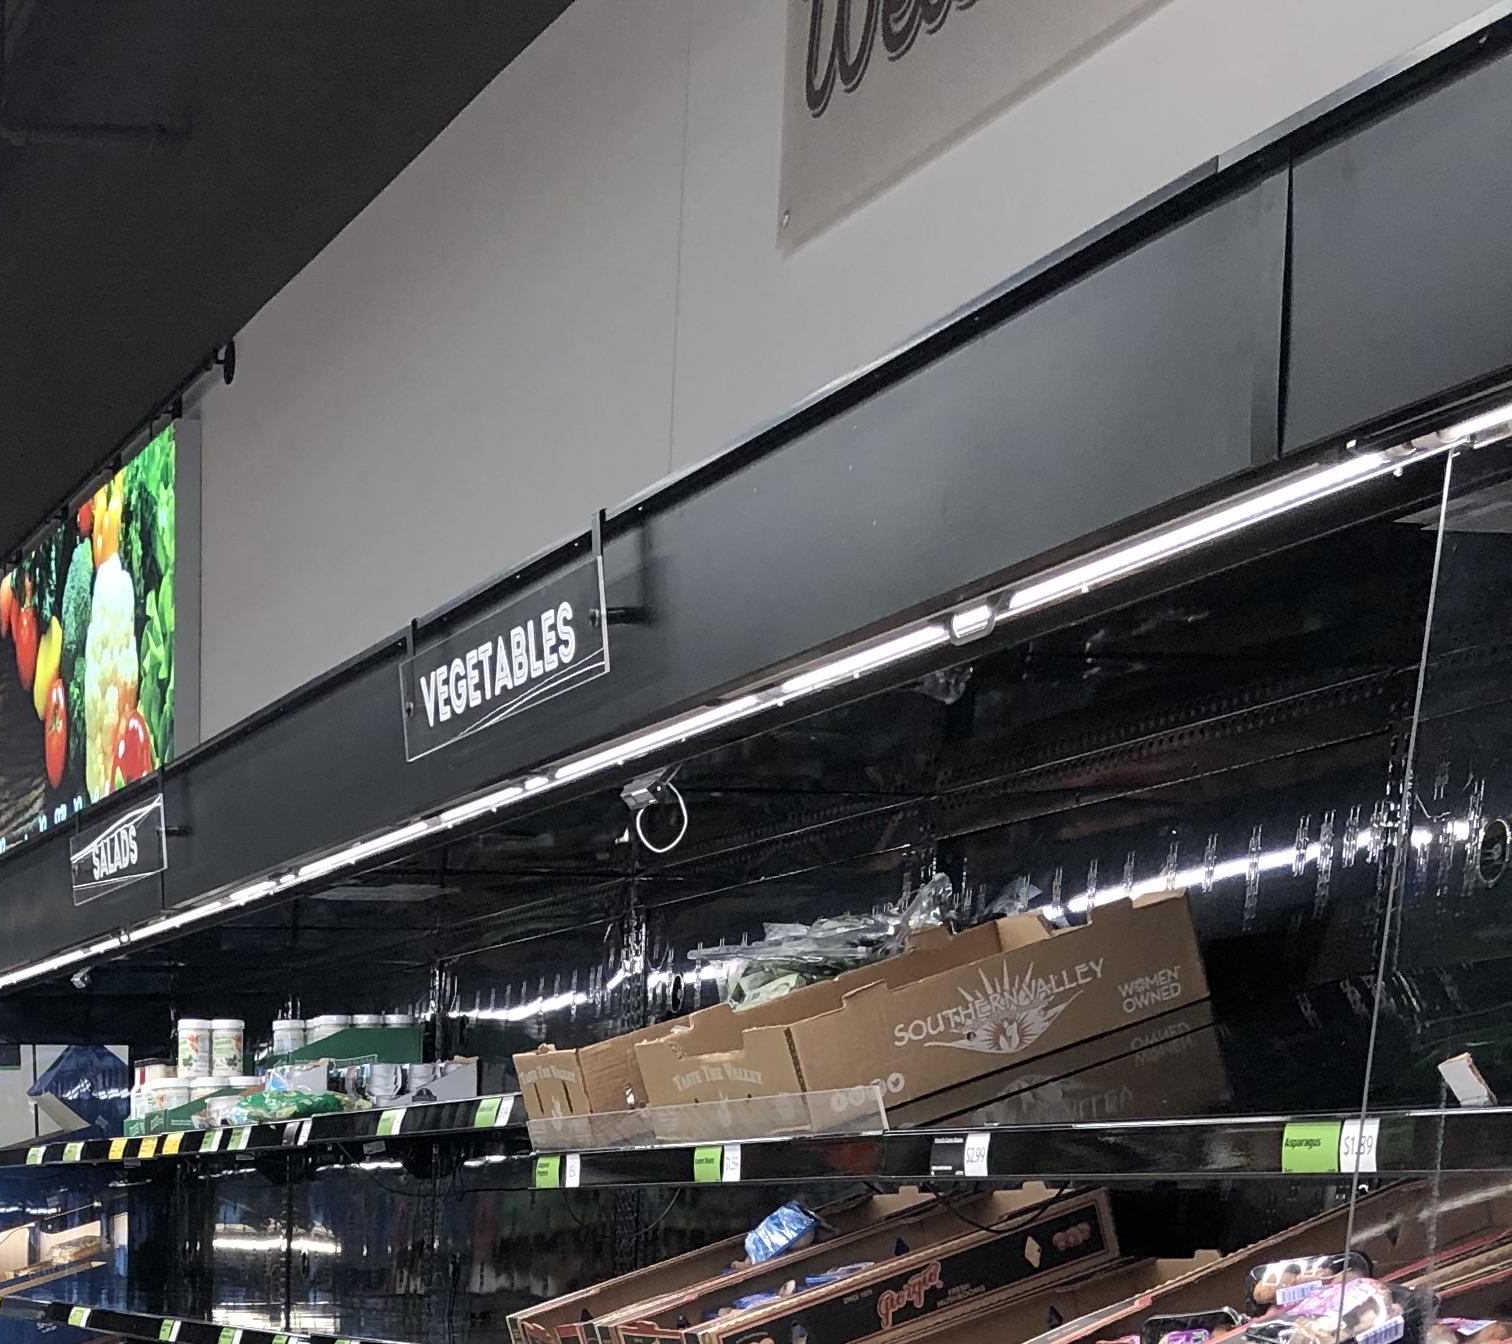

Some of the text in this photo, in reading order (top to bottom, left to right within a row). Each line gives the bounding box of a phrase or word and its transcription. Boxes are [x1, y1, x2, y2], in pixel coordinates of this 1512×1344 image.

[420, 602, 576, 727] VEGETABLES
[92, 825, 138, 880] SALADS
[894, 958, 1105, 1047] SOUTHERN VALLEY
[1117, 966, 1180, 998] WOMEN
[1122, 983, 1181, 1014] OWNED
[672, 1063, 764, 1093] TASTE THE VALLEY
